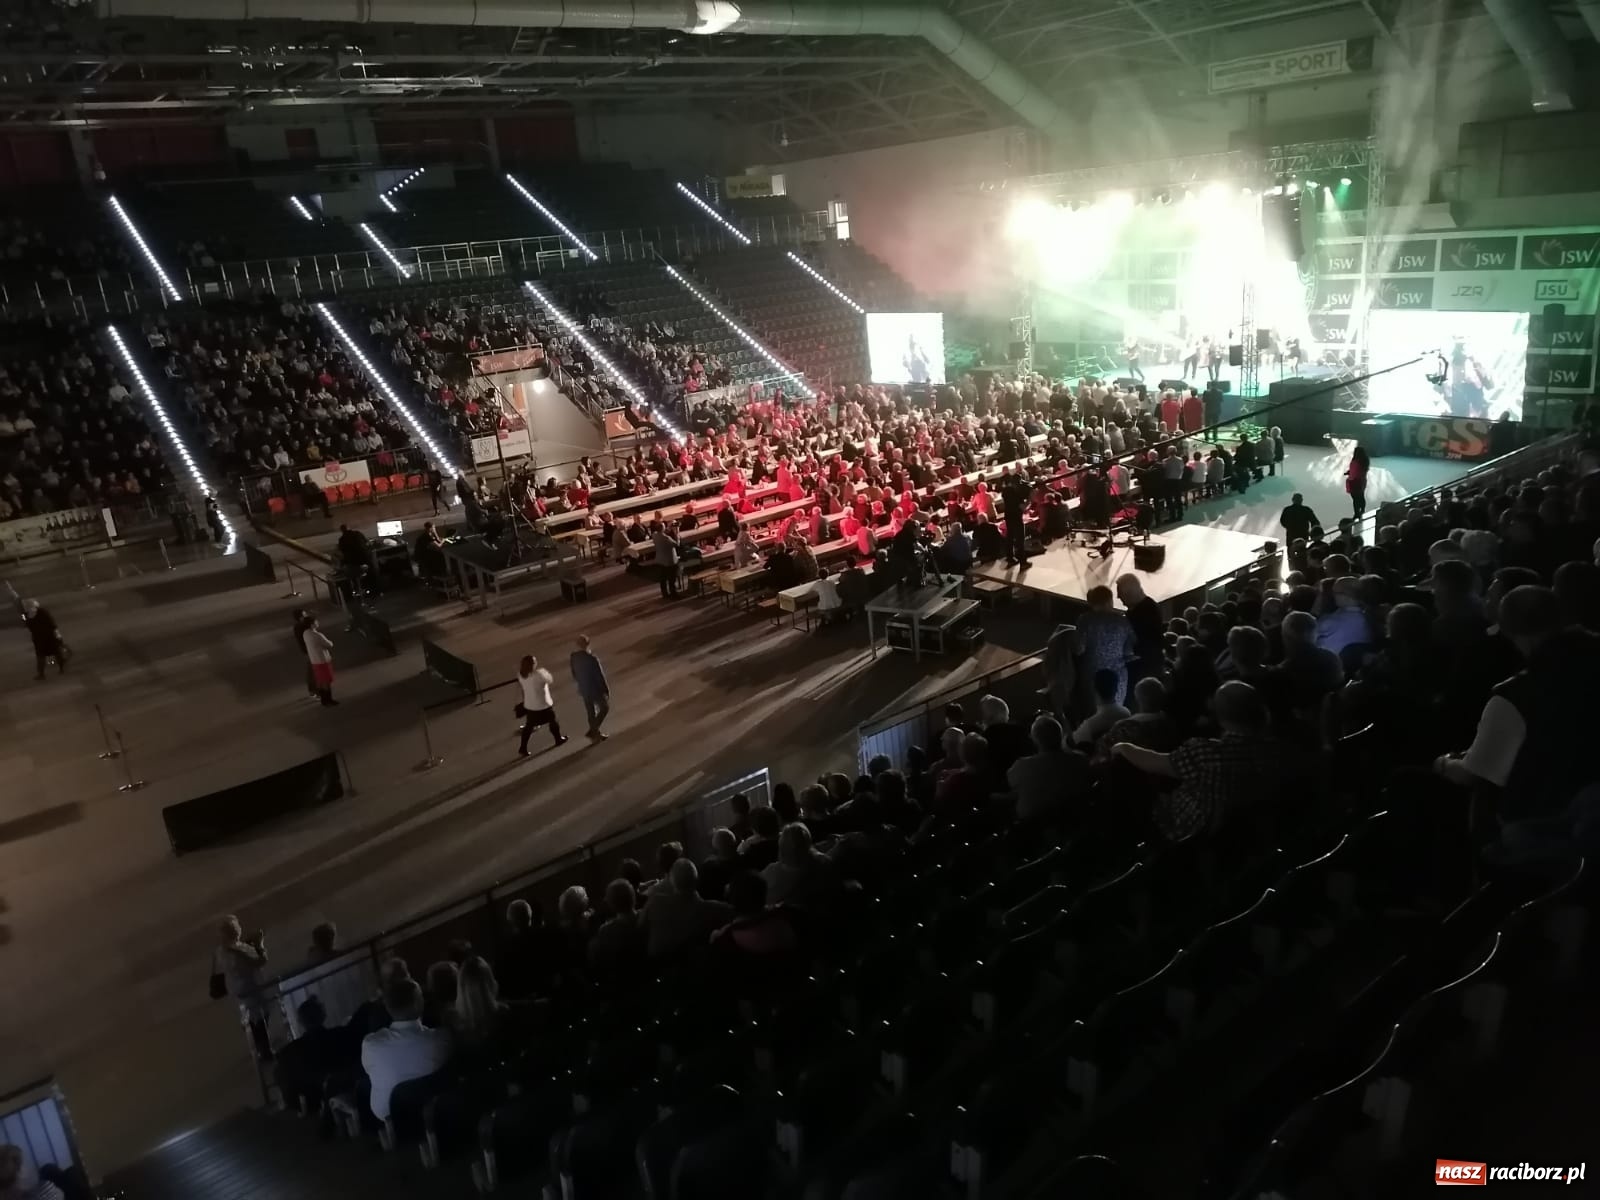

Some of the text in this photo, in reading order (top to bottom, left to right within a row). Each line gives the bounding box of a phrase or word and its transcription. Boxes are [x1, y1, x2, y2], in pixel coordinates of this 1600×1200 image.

[1274, 50, 1337, 75] SPORT
[1397, 256, 1426, 270] JSW
[1474, 252, 1506, 268] JSW
[1560, 249, 1594, 265] JSW
[1328, 258, 1354, 271] JSW
[1451, 286, 1485, 297] JZR
[1540, 284, 1569, 296] JSU
[1326, 293, 1352, 306] JSW
[1395, 292, 1424, 306] JSW
[1326, 328, 1348, 341] SW
[1551, 331, 1584, 345] JSW
[1548, 370, 1580, 384] JSW
